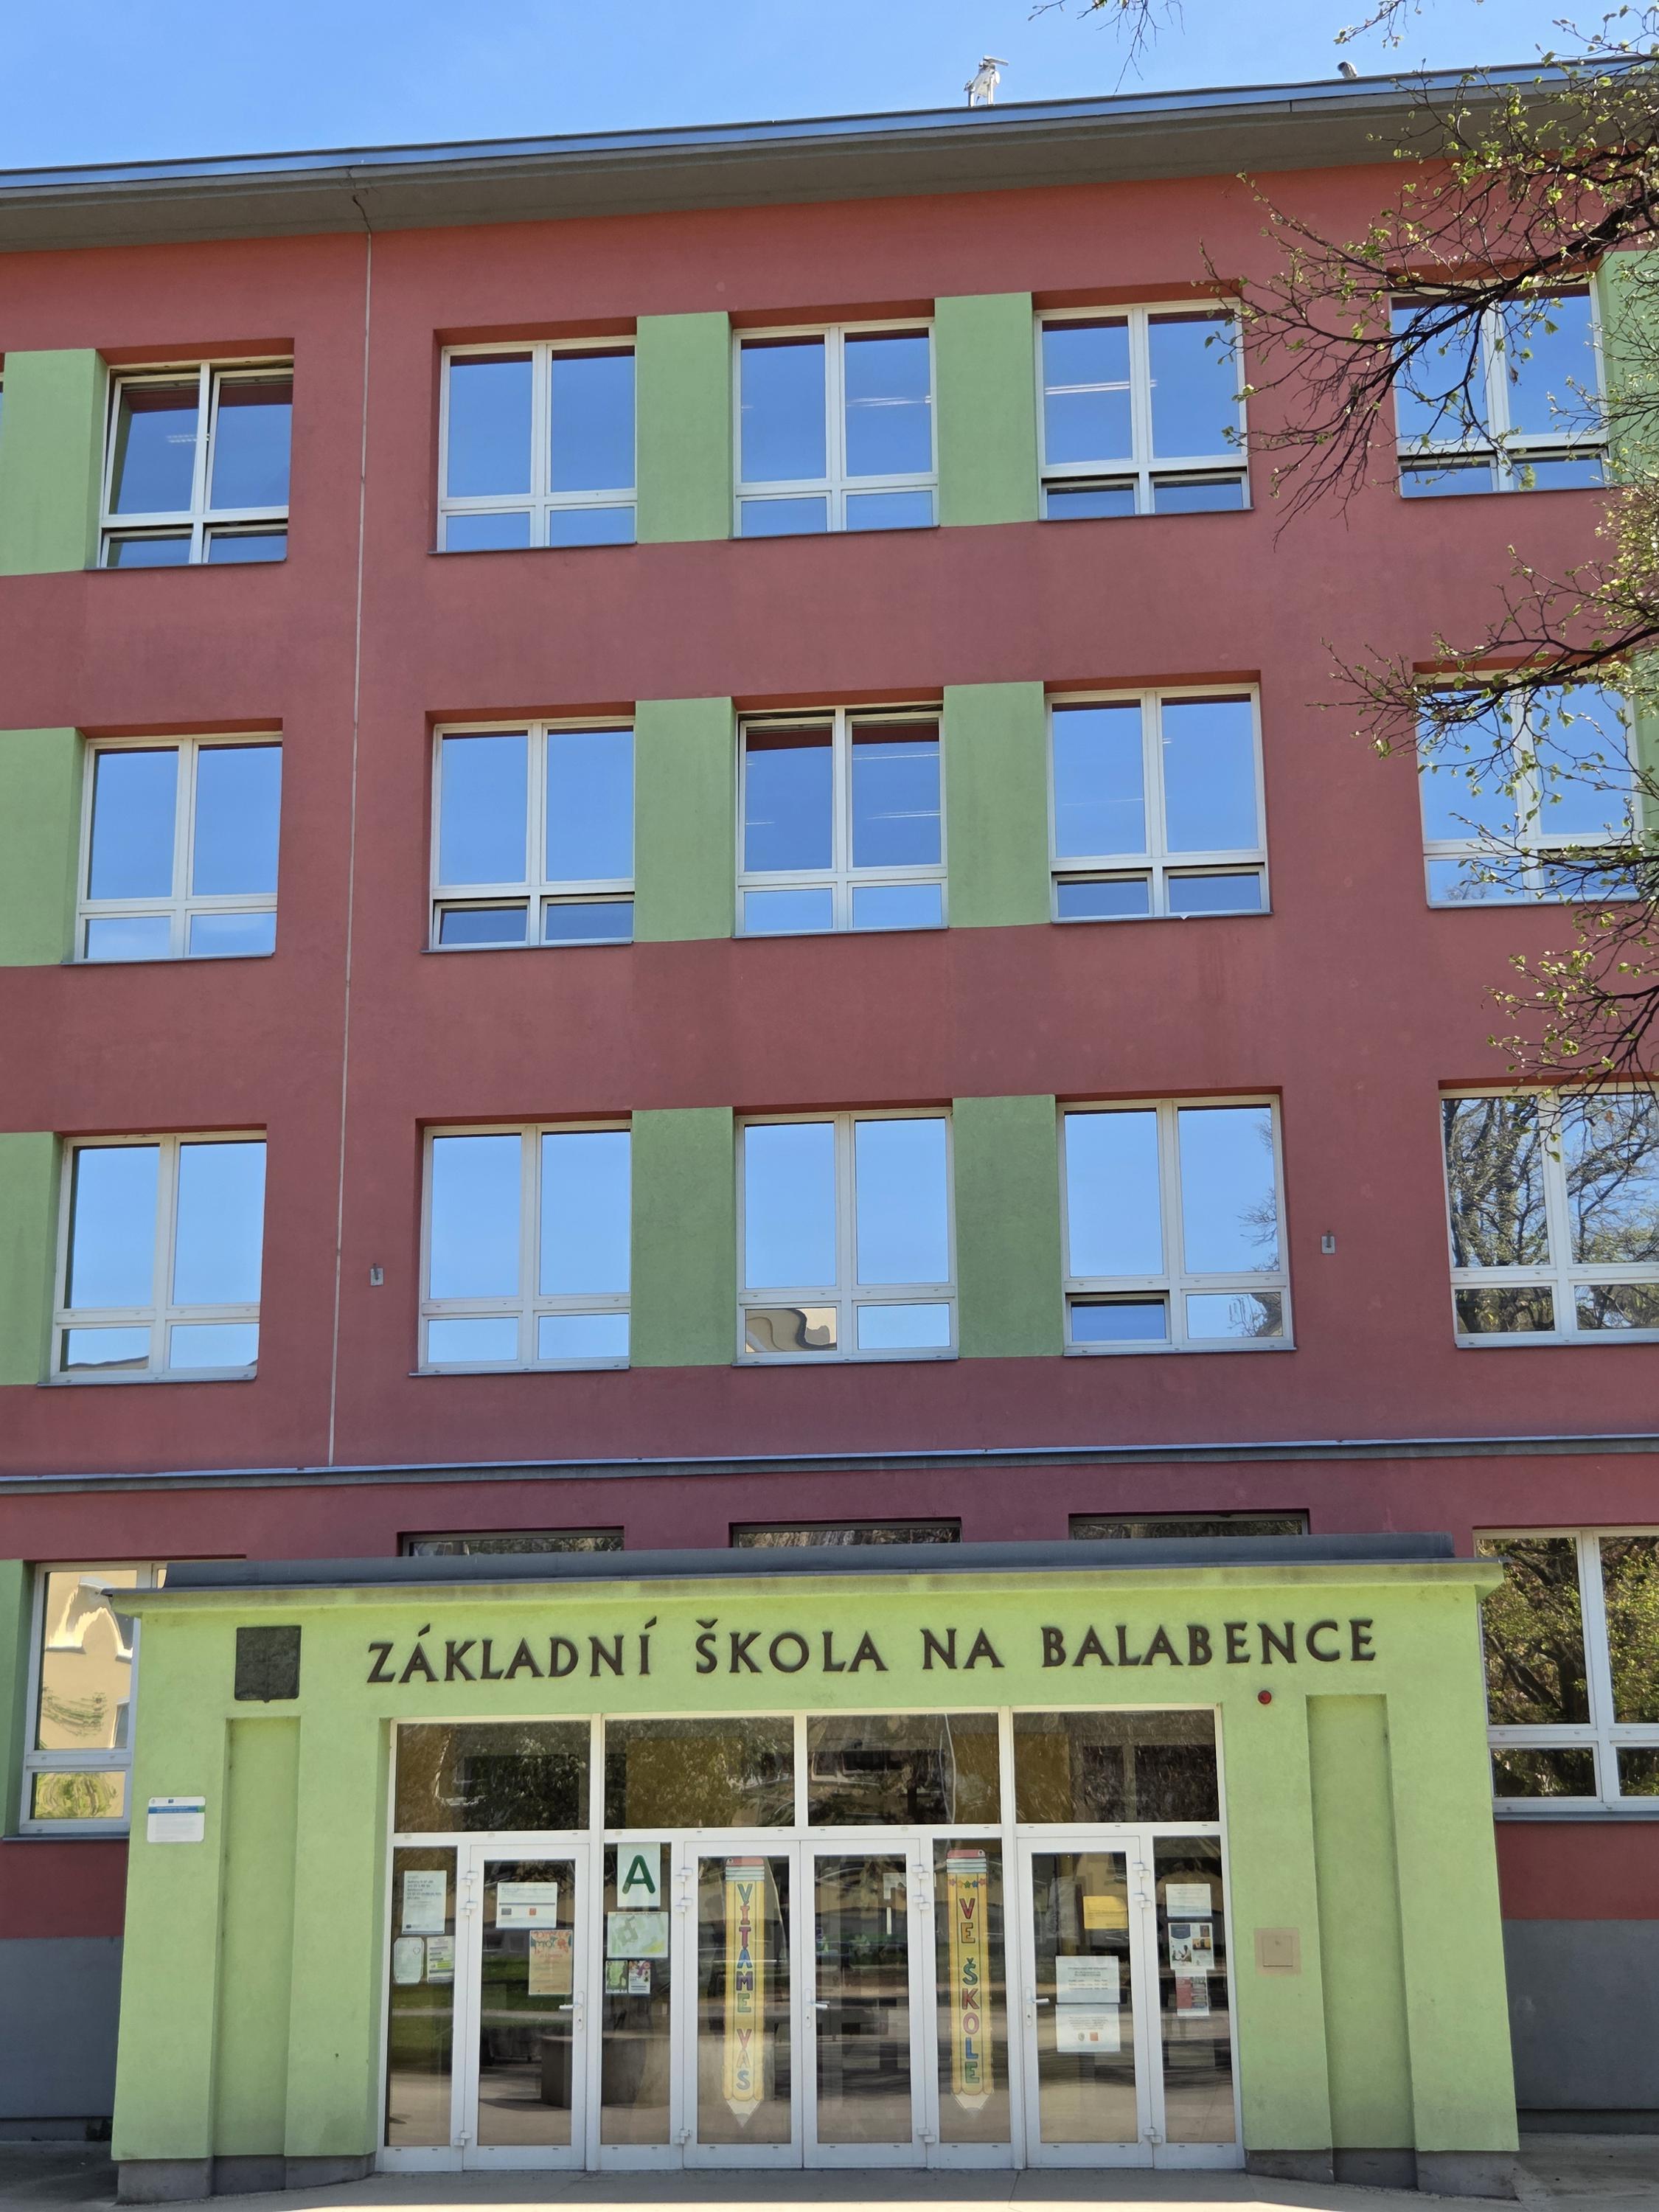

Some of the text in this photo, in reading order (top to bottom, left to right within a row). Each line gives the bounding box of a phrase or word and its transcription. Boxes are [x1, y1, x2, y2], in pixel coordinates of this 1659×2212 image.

[366, 1616, 1376, 1683] ZÁKLADNÍ ŠKOLA NA BALABENCE
[622, 1854, 655, 1893] A
[959, 1898, 979, 2084] VE ŠKOLE
